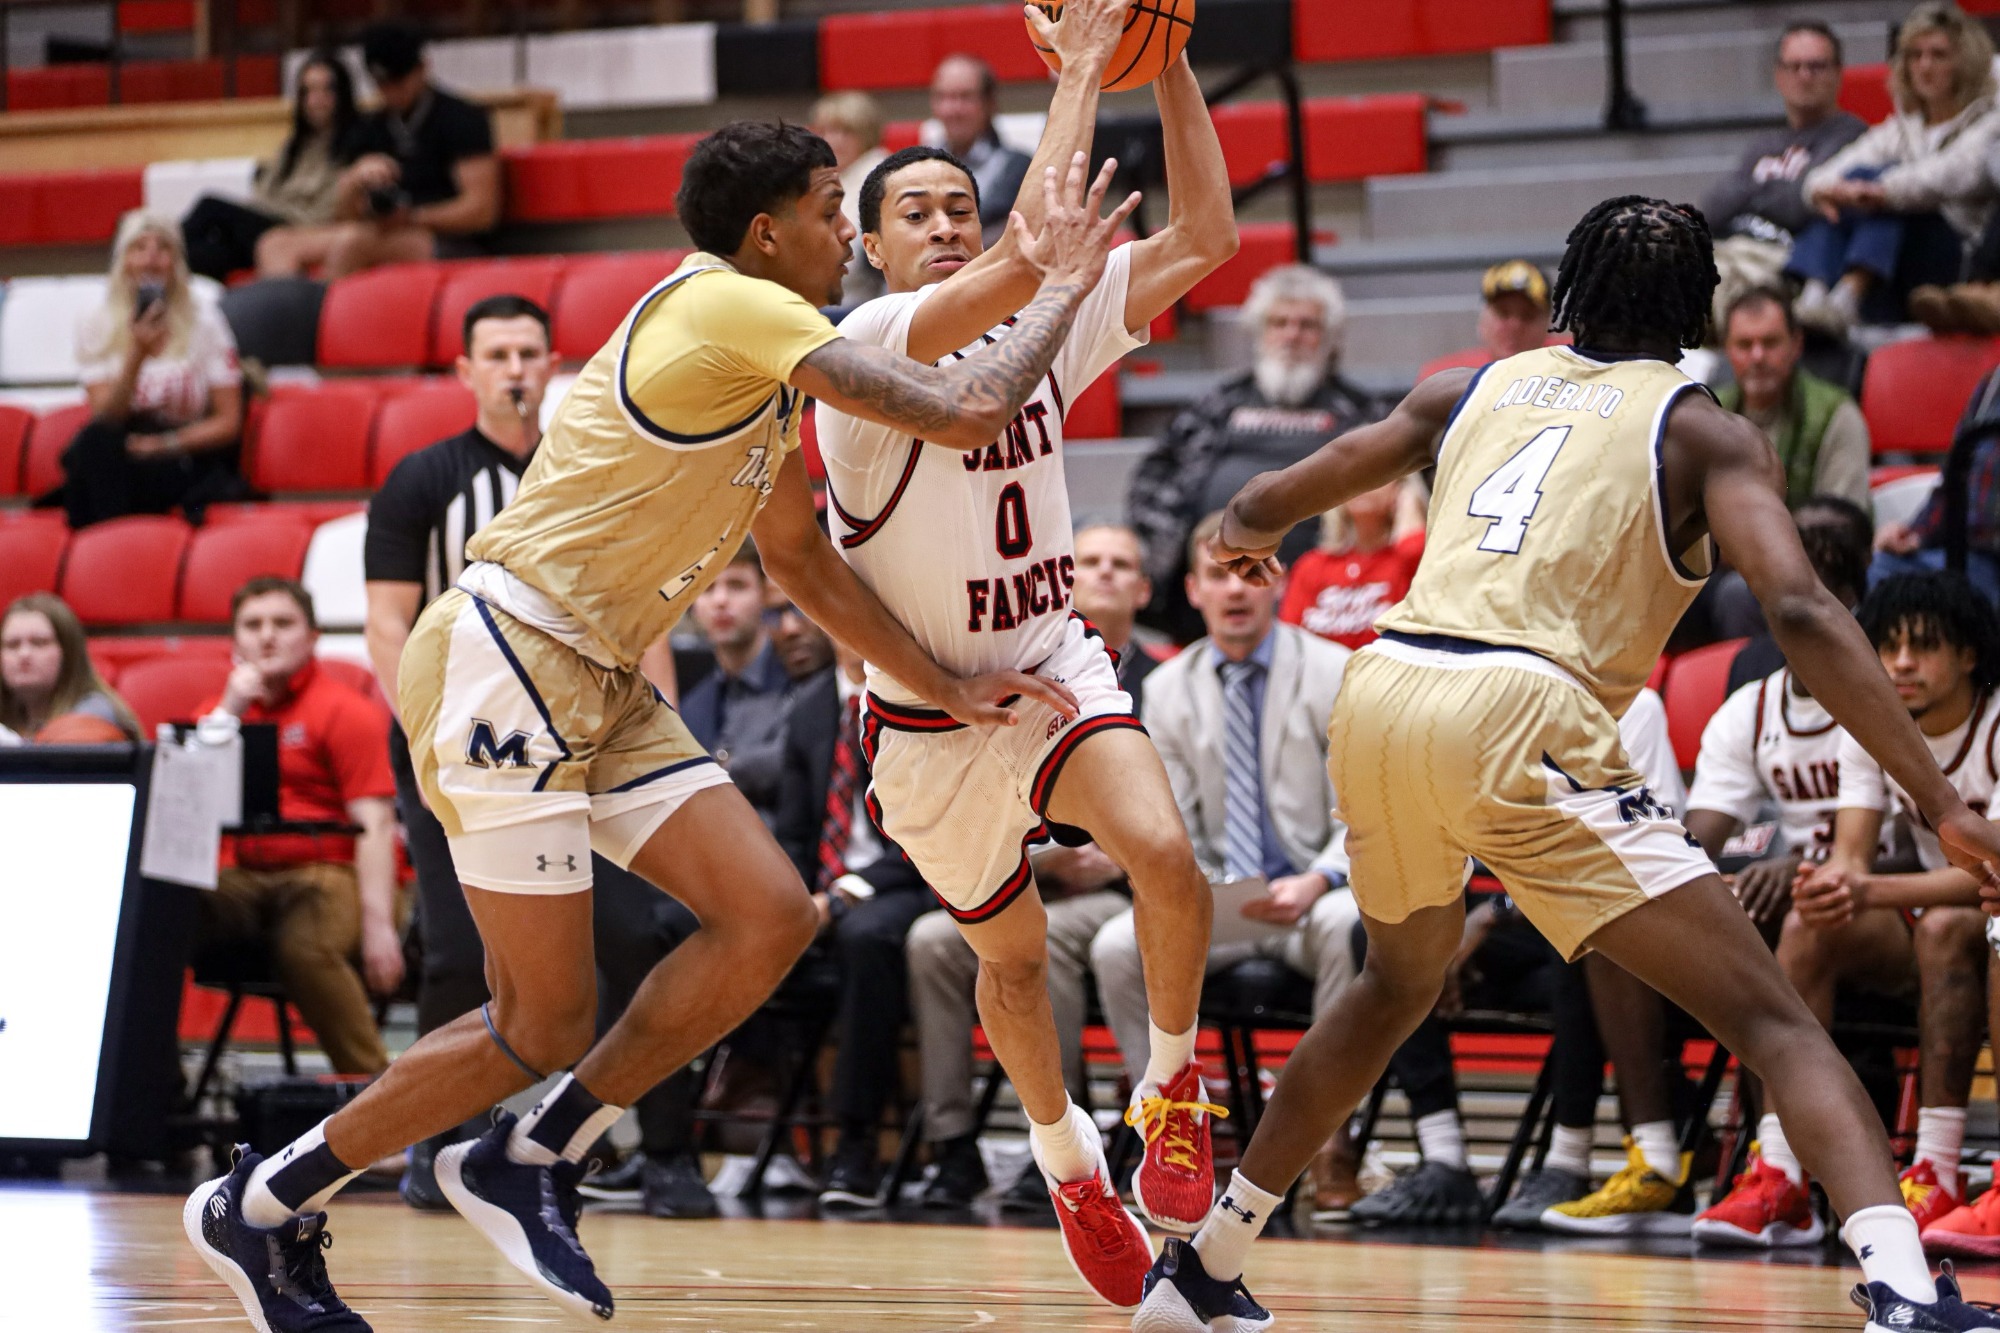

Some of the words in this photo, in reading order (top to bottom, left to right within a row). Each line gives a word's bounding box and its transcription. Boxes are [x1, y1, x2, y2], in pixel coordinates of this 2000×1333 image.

[1493, 375, 1624, 419] ADEBAYO
[996, 480, 1034, 560] 0
[1467, 425, 1573, 555] 4
[465, 717, 538, 769] M
